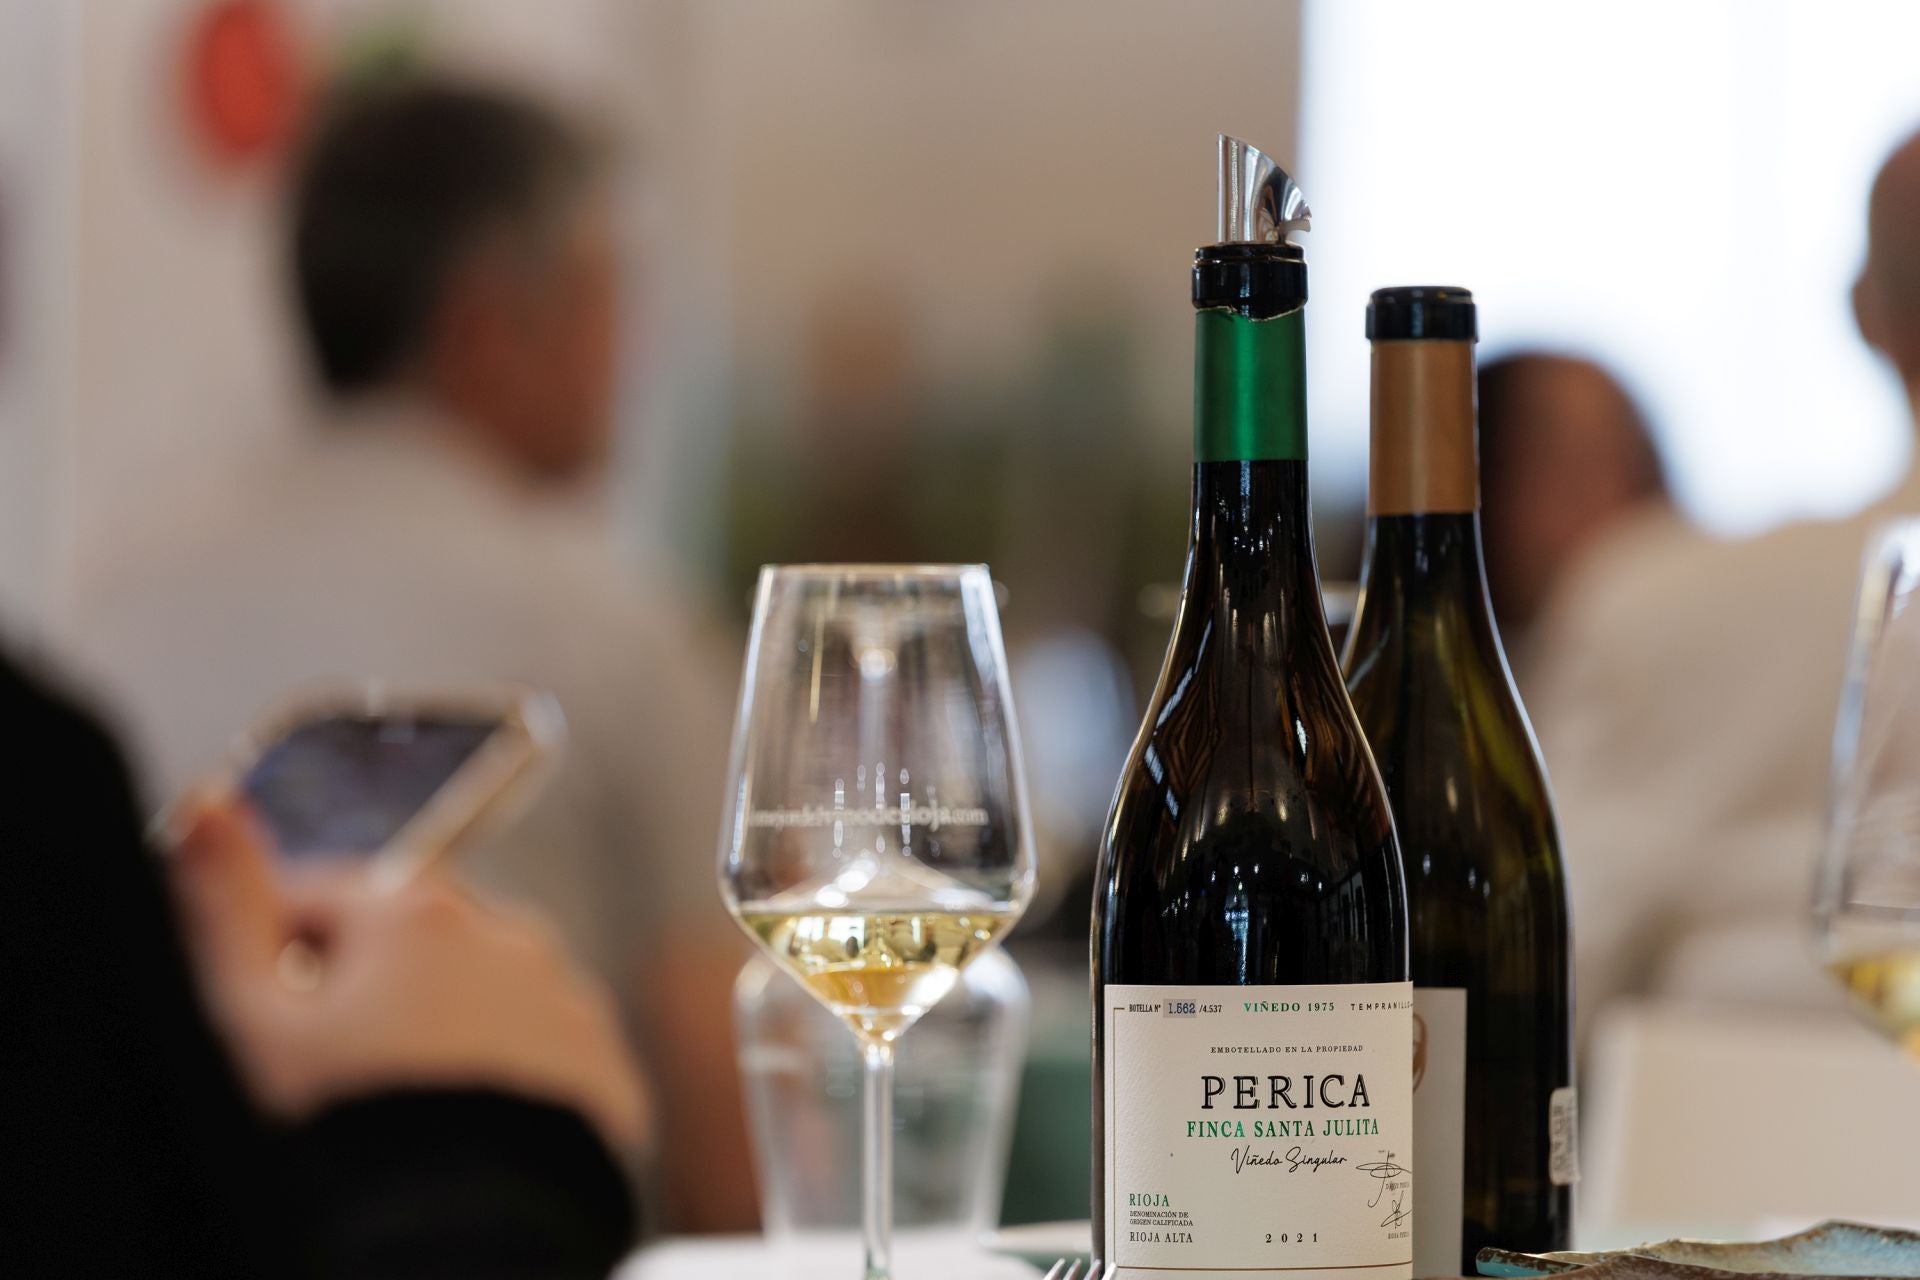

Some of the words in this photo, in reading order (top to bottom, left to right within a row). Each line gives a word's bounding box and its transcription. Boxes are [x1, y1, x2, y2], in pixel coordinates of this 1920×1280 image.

[1129, 1003, 1153, 1013] BOTELLA
[1243, 1001, 1301, 1013] VIÑEDO
[1308, 1002, 1335, 1012] 1975
[1210, 1046, 1282, 1054] EMBOTELLADO
[1316, 1045, 1363, 1053] PROPIEDAD
[1201, 1074, 1370, 1110] PERICA
[1186, 1120, 1246, 1138] FINCA
[1254, 1119, 1315, 1138] SANTA
[1323, 1118, 1379, 1137] JULITA
[1231, 1145, 1282, 1174] Viñedo
[1285, 1146, 1348, 1173] Singular
[1129, 1193, 1170, 1207] RIOJA
[1129, 1210, 1177, 1218] DENOMINACIÓN
[1129, 1218, 1152, 1226] ORIGEN
[1152, 1219, 1194, 1227] CALIFICADA
[1129, 1232, 1160, 1243] RIOJA
[1164, 1232, 1193, 1243] ALTA
[1265, 1233, 1319, 1243] 2021
